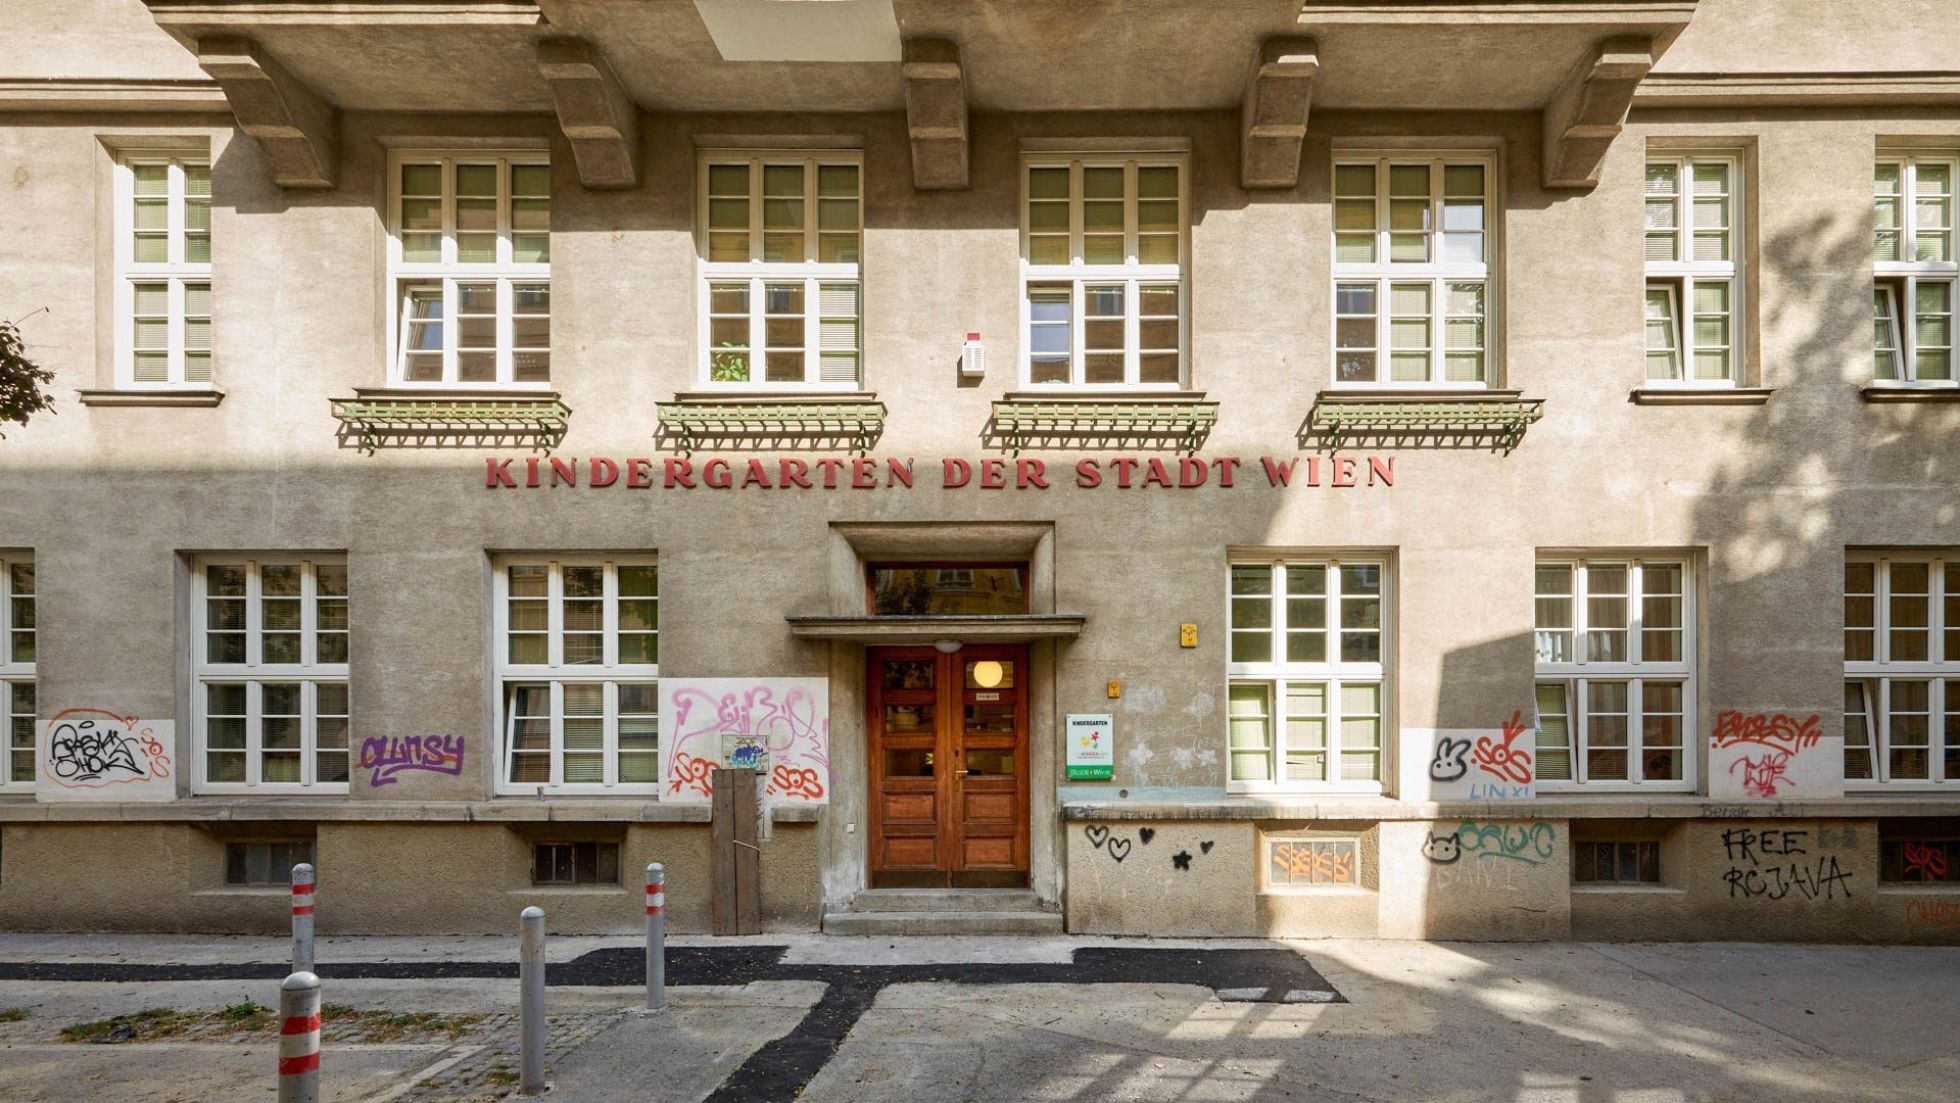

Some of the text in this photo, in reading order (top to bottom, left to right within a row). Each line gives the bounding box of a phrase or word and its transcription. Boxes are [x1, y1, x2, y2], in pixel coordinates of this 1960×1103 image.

[485, 456, 1396, 488] KINDERGARTEN DER STADT WIEN
[1473, 735, 1531, 784] SOS
[772, 764, 824, 798] SOS
[1721, 828, 1808, 866] FREE
[1904, 841, 1950, 877] SOS
